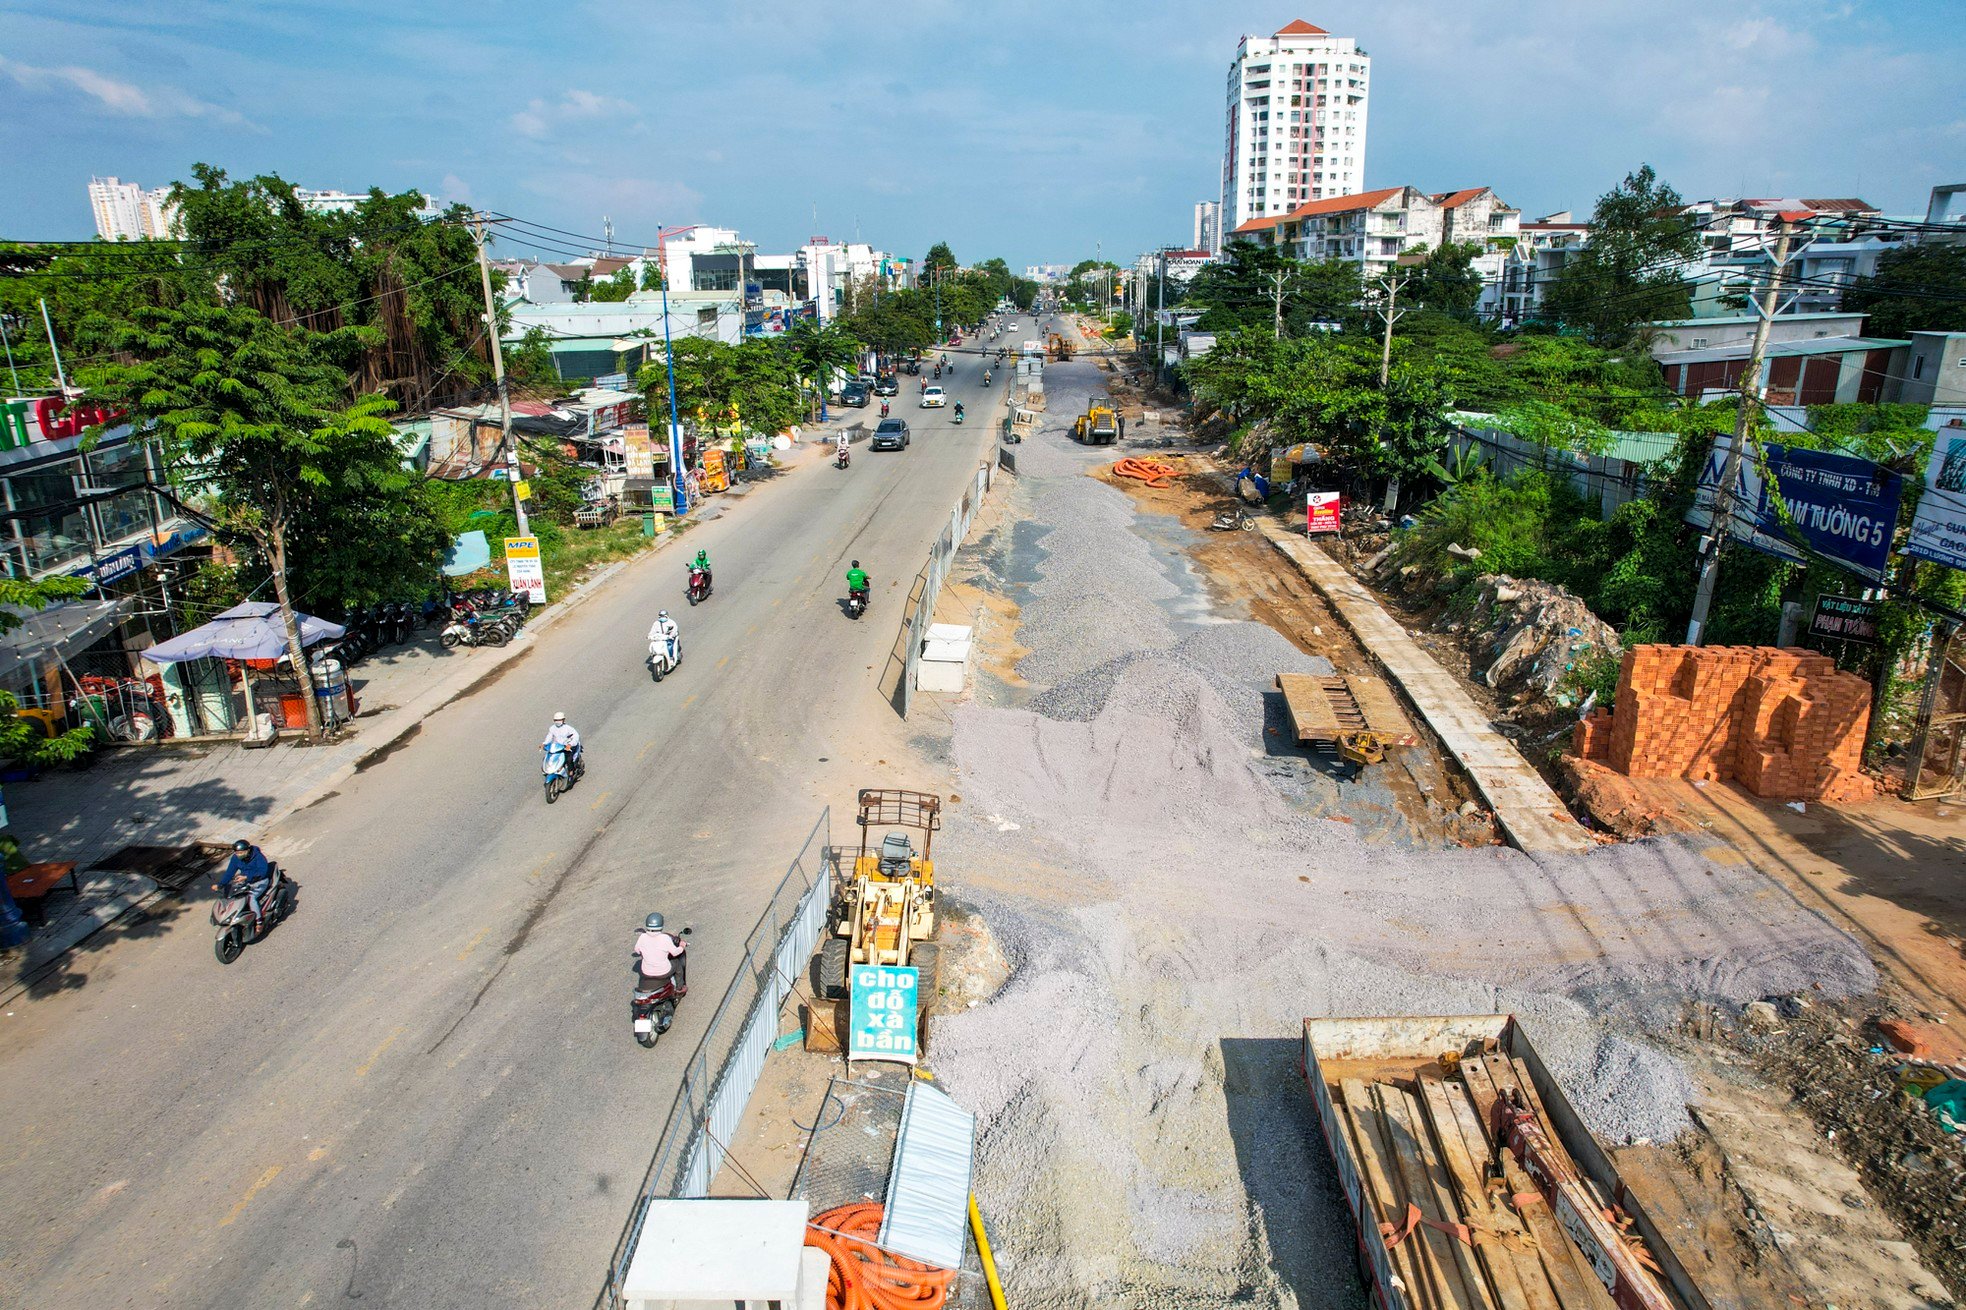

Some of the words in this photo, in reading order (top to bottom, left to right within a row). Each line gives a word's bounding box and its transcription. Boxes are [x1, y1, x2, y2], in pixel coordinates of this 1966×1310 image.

[1780, 463, 1803, 480] CÔNG
[1805, 469, 1817, 483] TY
[1818, 472, 1842, 489] TNHH
[1842, 478, 1857, 492] XD
[1810, 503, 1871, 543] TƯỜNG
[1870, 521, 1885, 546] 5
[508, 541, 535, 549] MPE
[1815, 614, 1843, 633] PHẠM
[859, 969, 914, 988] cho
[867, 1011, 904, 1029] xà
